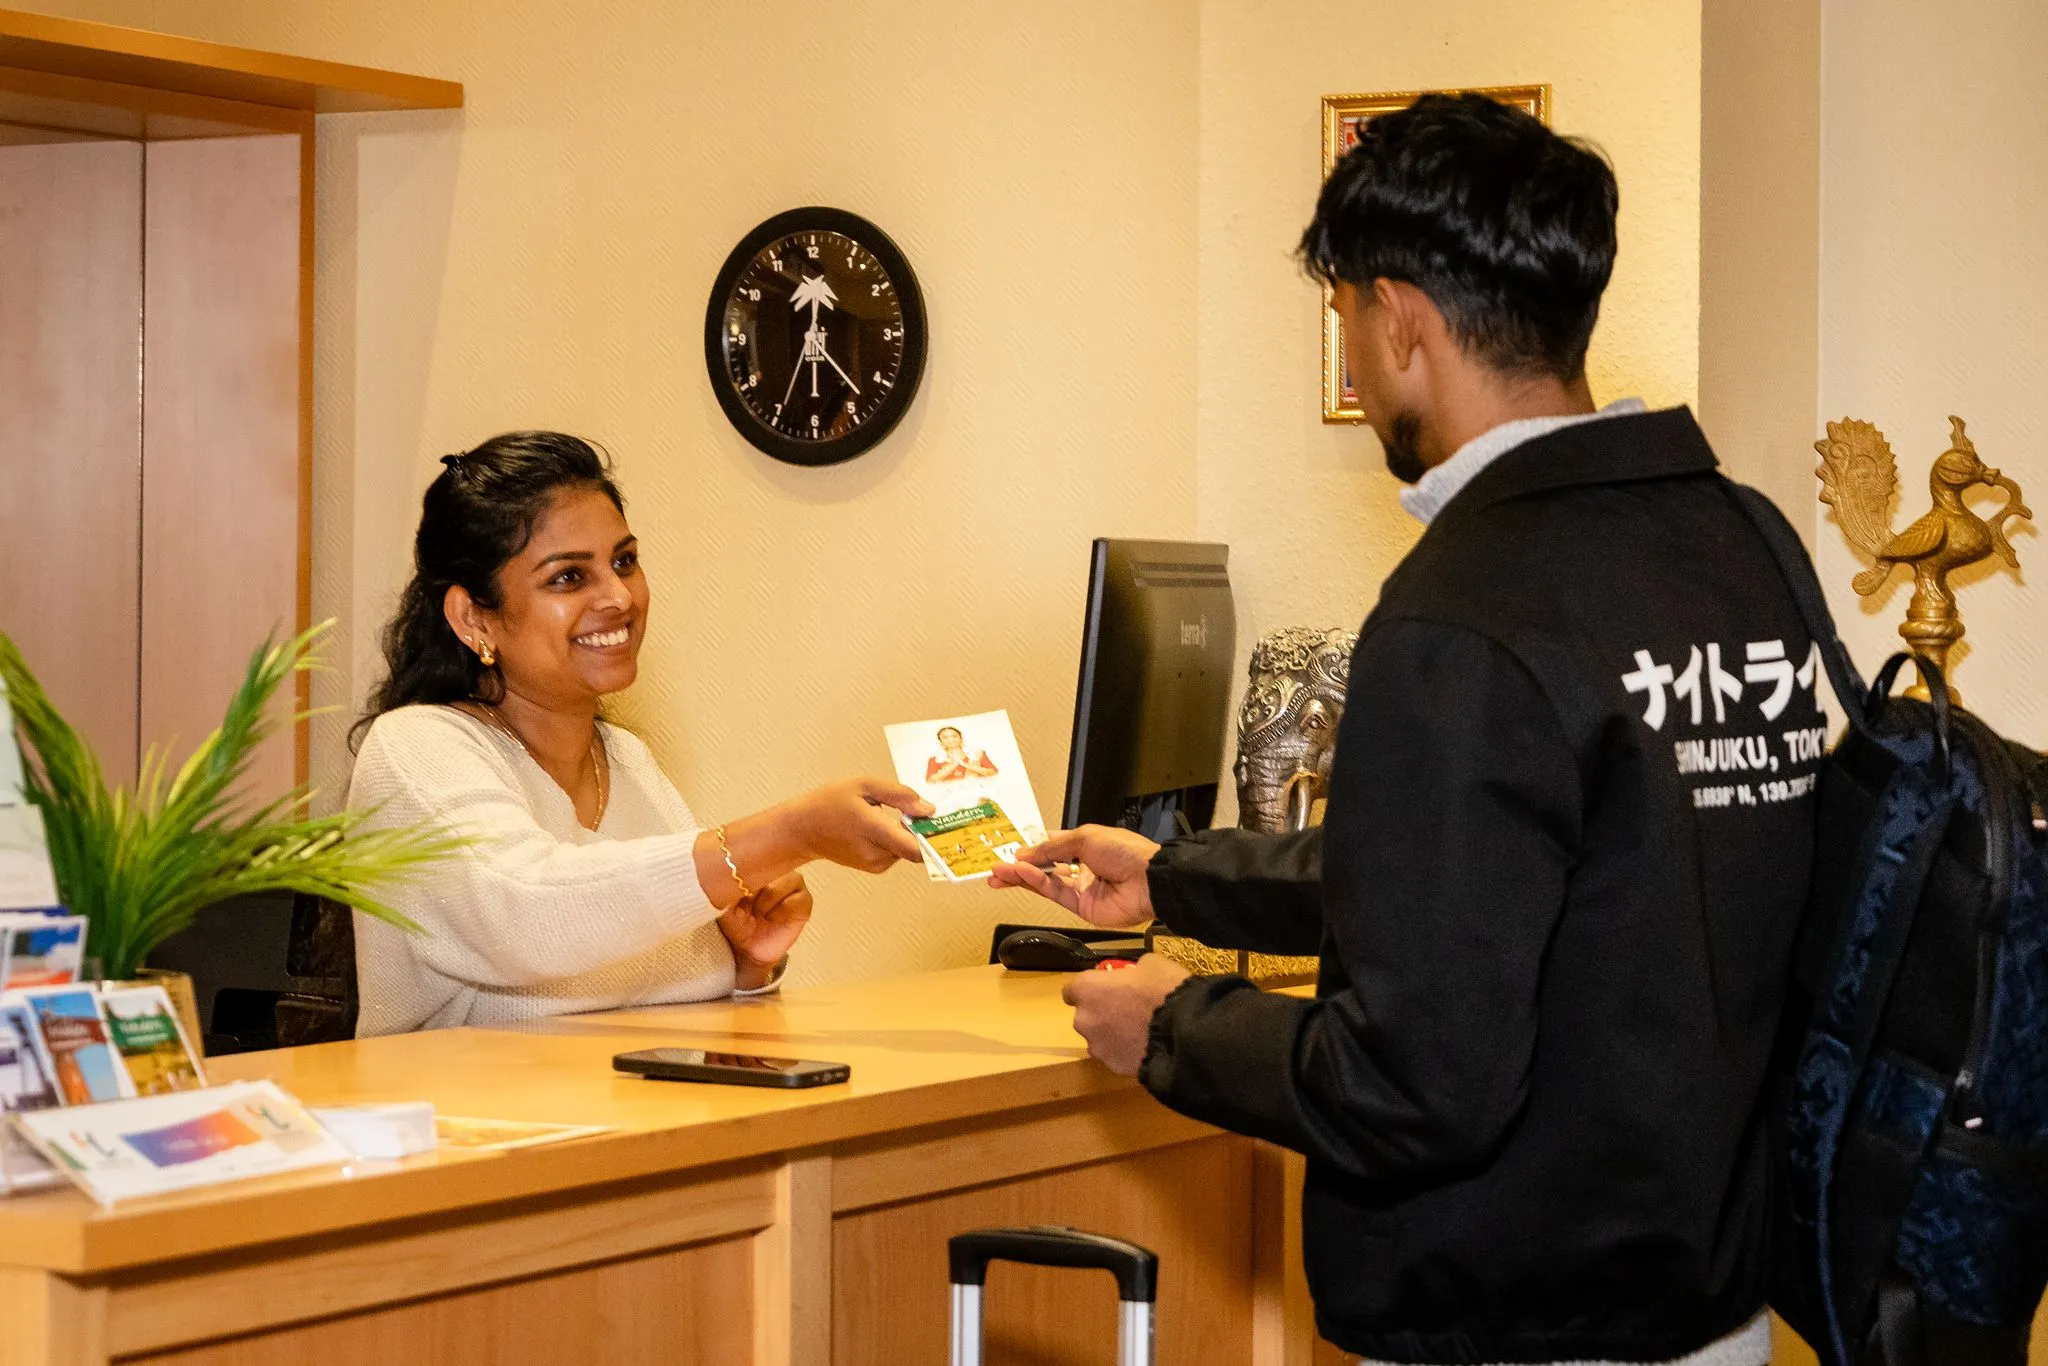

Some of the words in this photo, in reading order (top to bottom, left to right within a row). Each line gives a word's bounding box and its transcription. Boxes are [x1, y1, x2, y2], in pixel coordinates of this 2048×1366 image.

[807, 246, 819, 258] 12
[773, 260, 782, 271] 11
[847, 257, 852, 268] 1
[749, 289, 760, 301] 10
[872, 285, 879, 296] 2
[739, 334, 746, 345] 9
[884, 329, 893, 340] 3
[750, 375, 756, 386] 8
[874, 372, 881, 383] 4
[775, 404, 782, 415] 7
[847, 402, 855, 413] 5
[811, 415, 818, 426] 6
